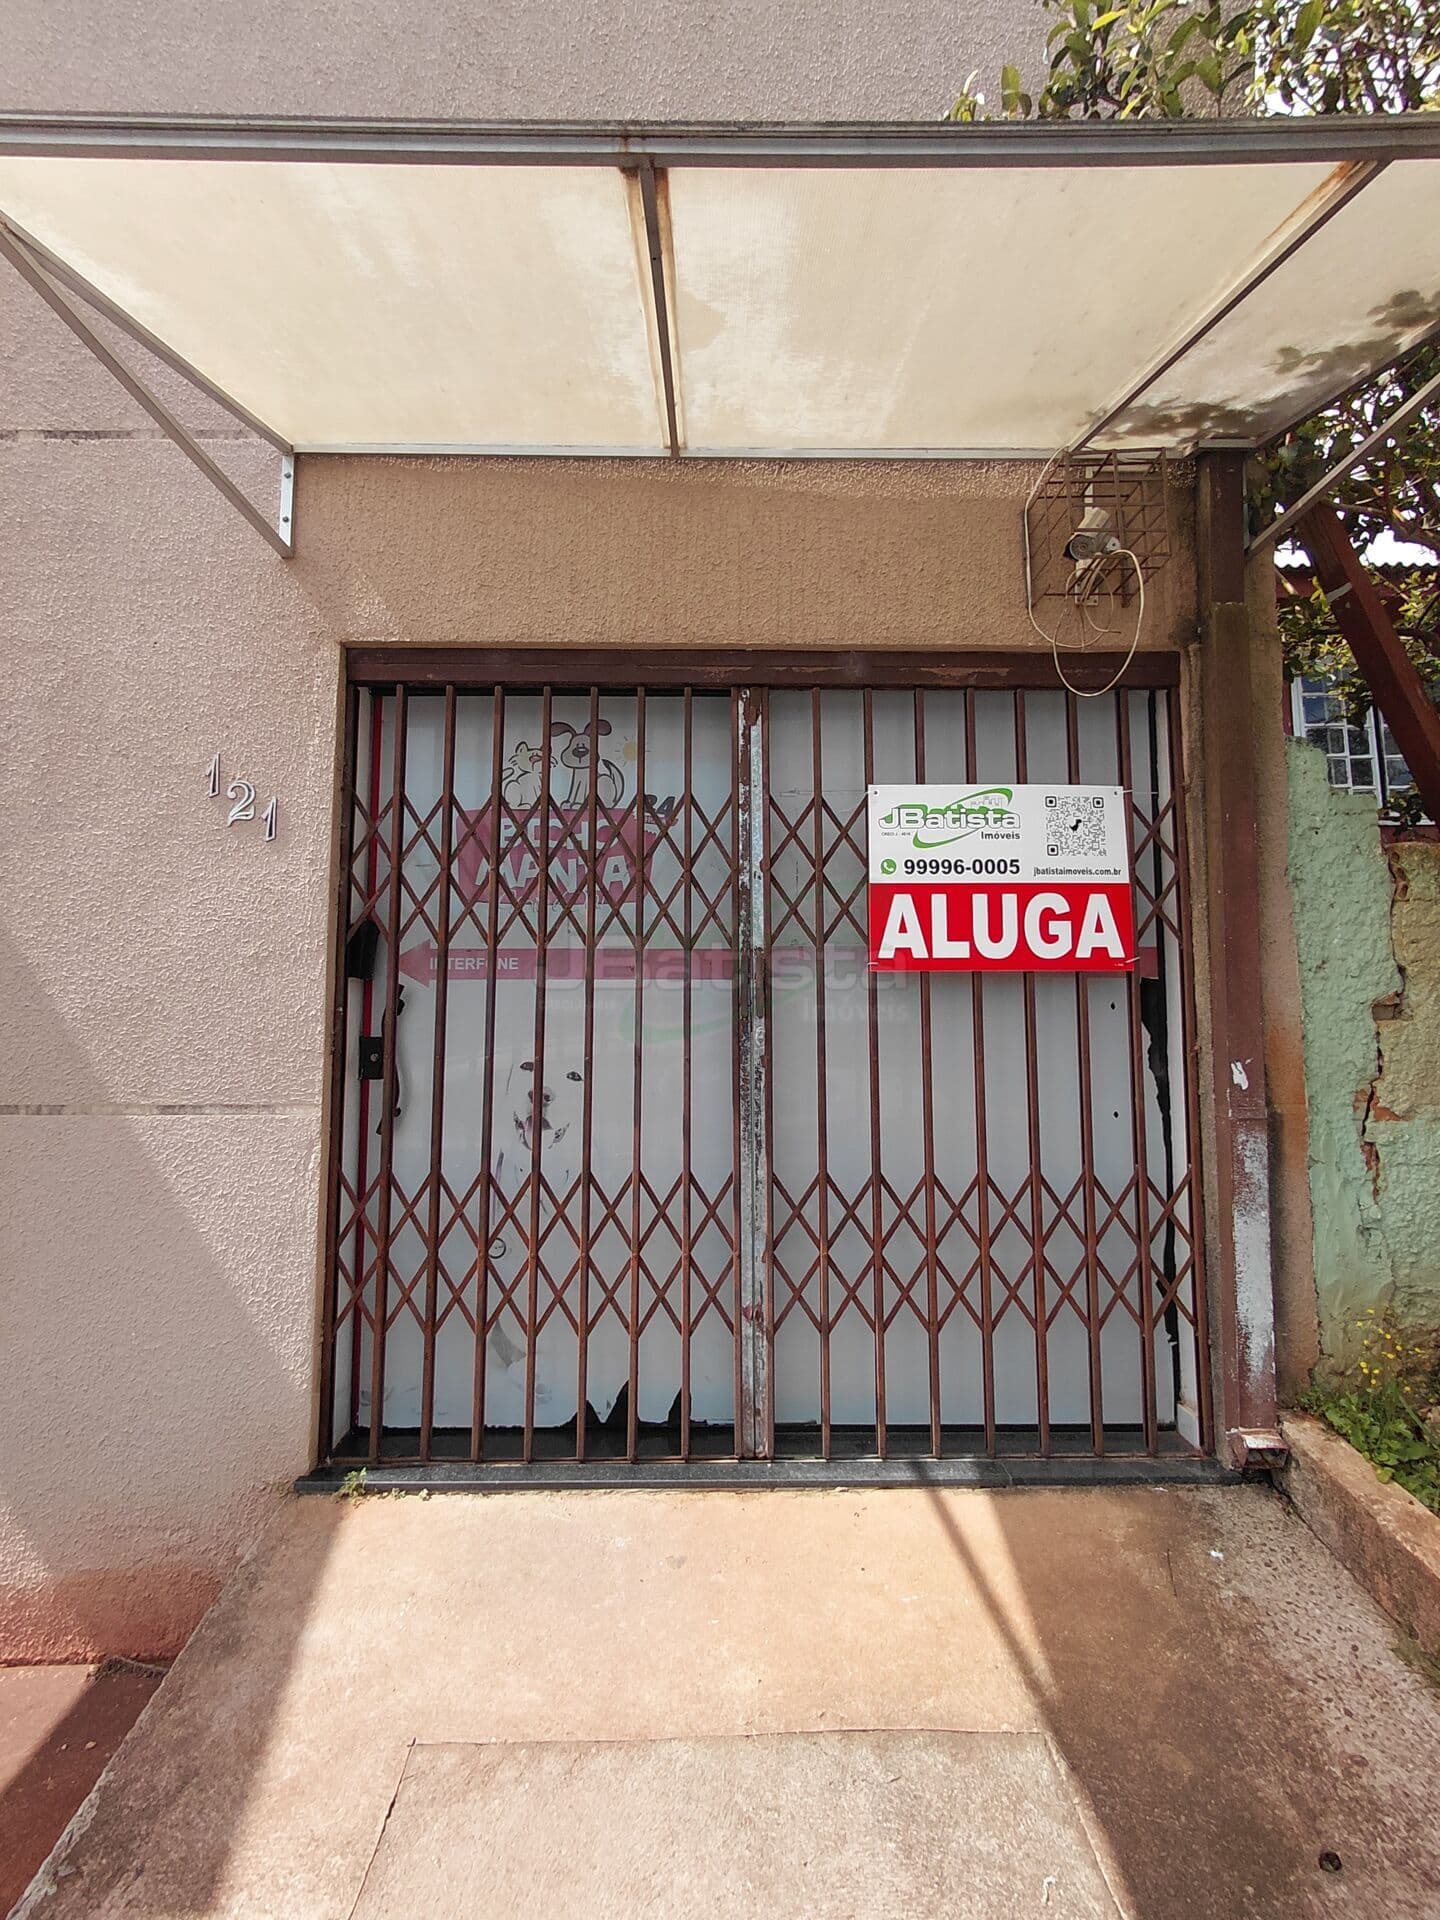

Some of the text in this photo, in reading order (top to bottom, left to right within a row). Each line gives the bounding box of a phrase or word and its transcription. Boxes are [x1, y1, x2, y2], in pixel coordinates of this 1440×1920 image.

[206, 752, 277, 842] 121
[878, 806, 1020, 829] JBatista
[981, 831, 1020, 840] Imóveis
[475, 853, 631, 893] MANA
[904, 859, 1020, 874] 99996-0005
[1033, 867, 1121, 877] jbatistaimoveis.com.br
[878, 892, 1126, 959] ALUGA
[430, 957, 519, 970] ITERFNE
